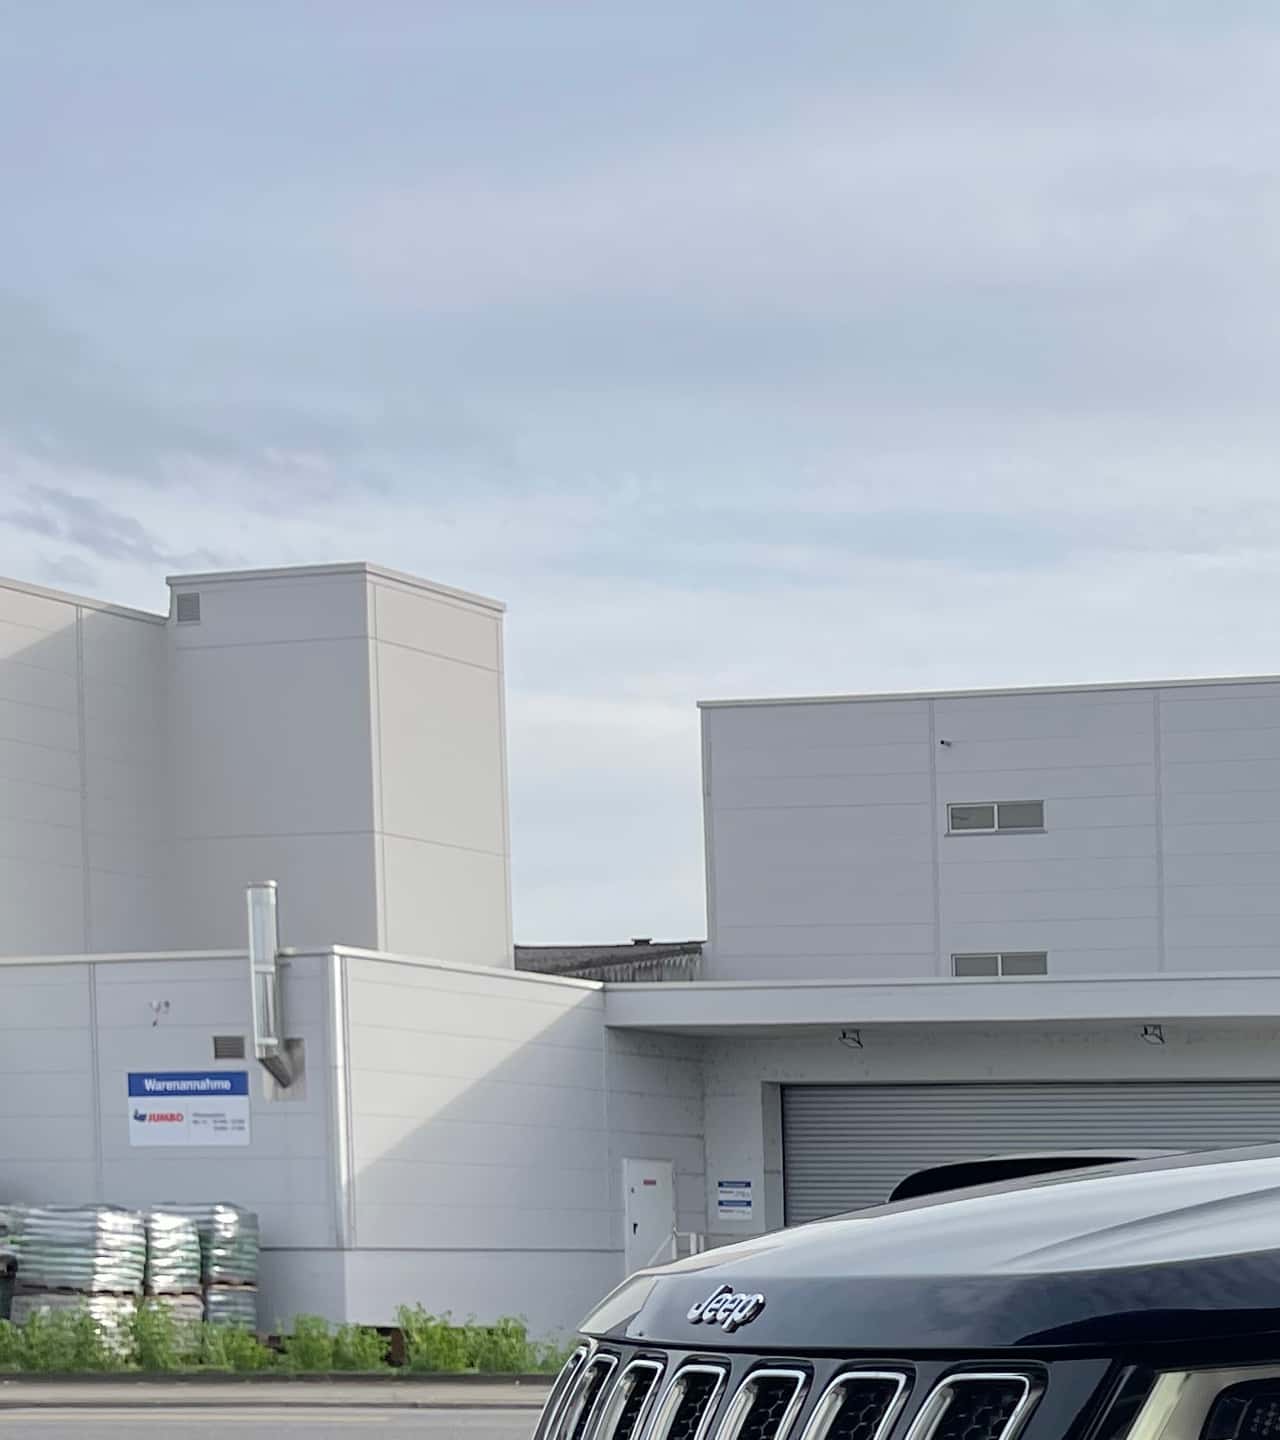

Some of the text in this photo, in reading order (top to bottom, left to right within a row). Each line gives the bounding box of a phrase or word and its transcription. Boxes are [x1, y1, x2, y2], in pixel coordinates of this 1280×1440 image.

[144, 1078, 232, 1092] Warenannahme
[148, 1112, 184, 1123] JUMBO
[687, 1284, 766, 1333] Jeep
